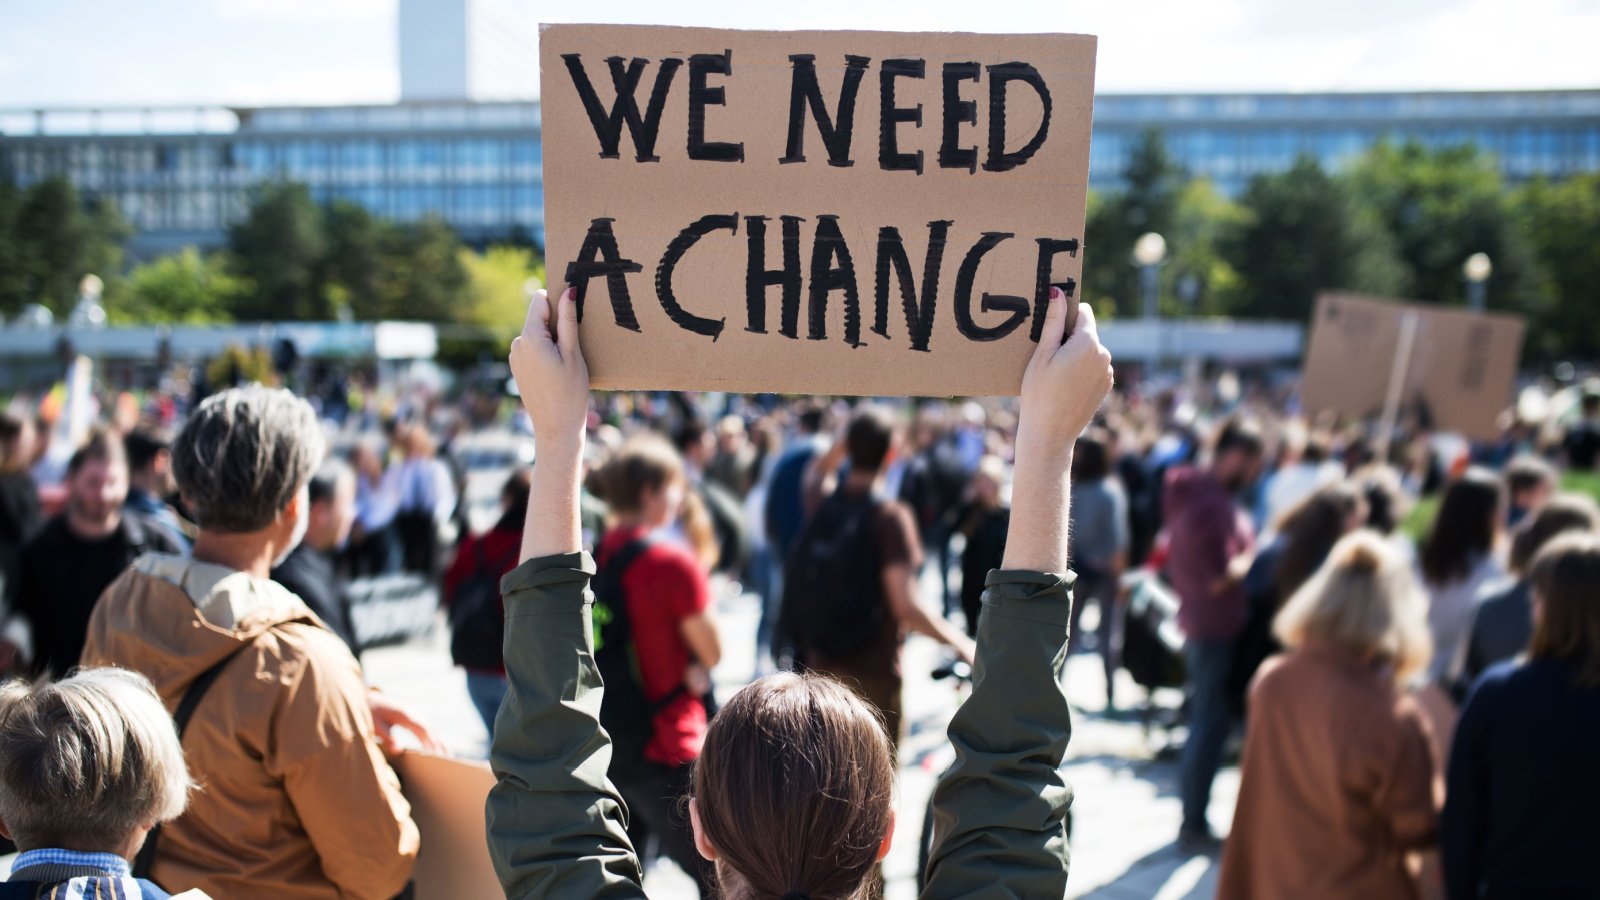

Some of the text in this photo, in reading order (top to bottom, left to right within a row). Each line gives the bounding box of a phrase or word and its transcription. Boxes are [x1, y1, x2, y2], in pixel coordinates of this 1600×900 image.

[560, 48, 1053, 176] WE NEED
[564, 217, 644, 333] A
